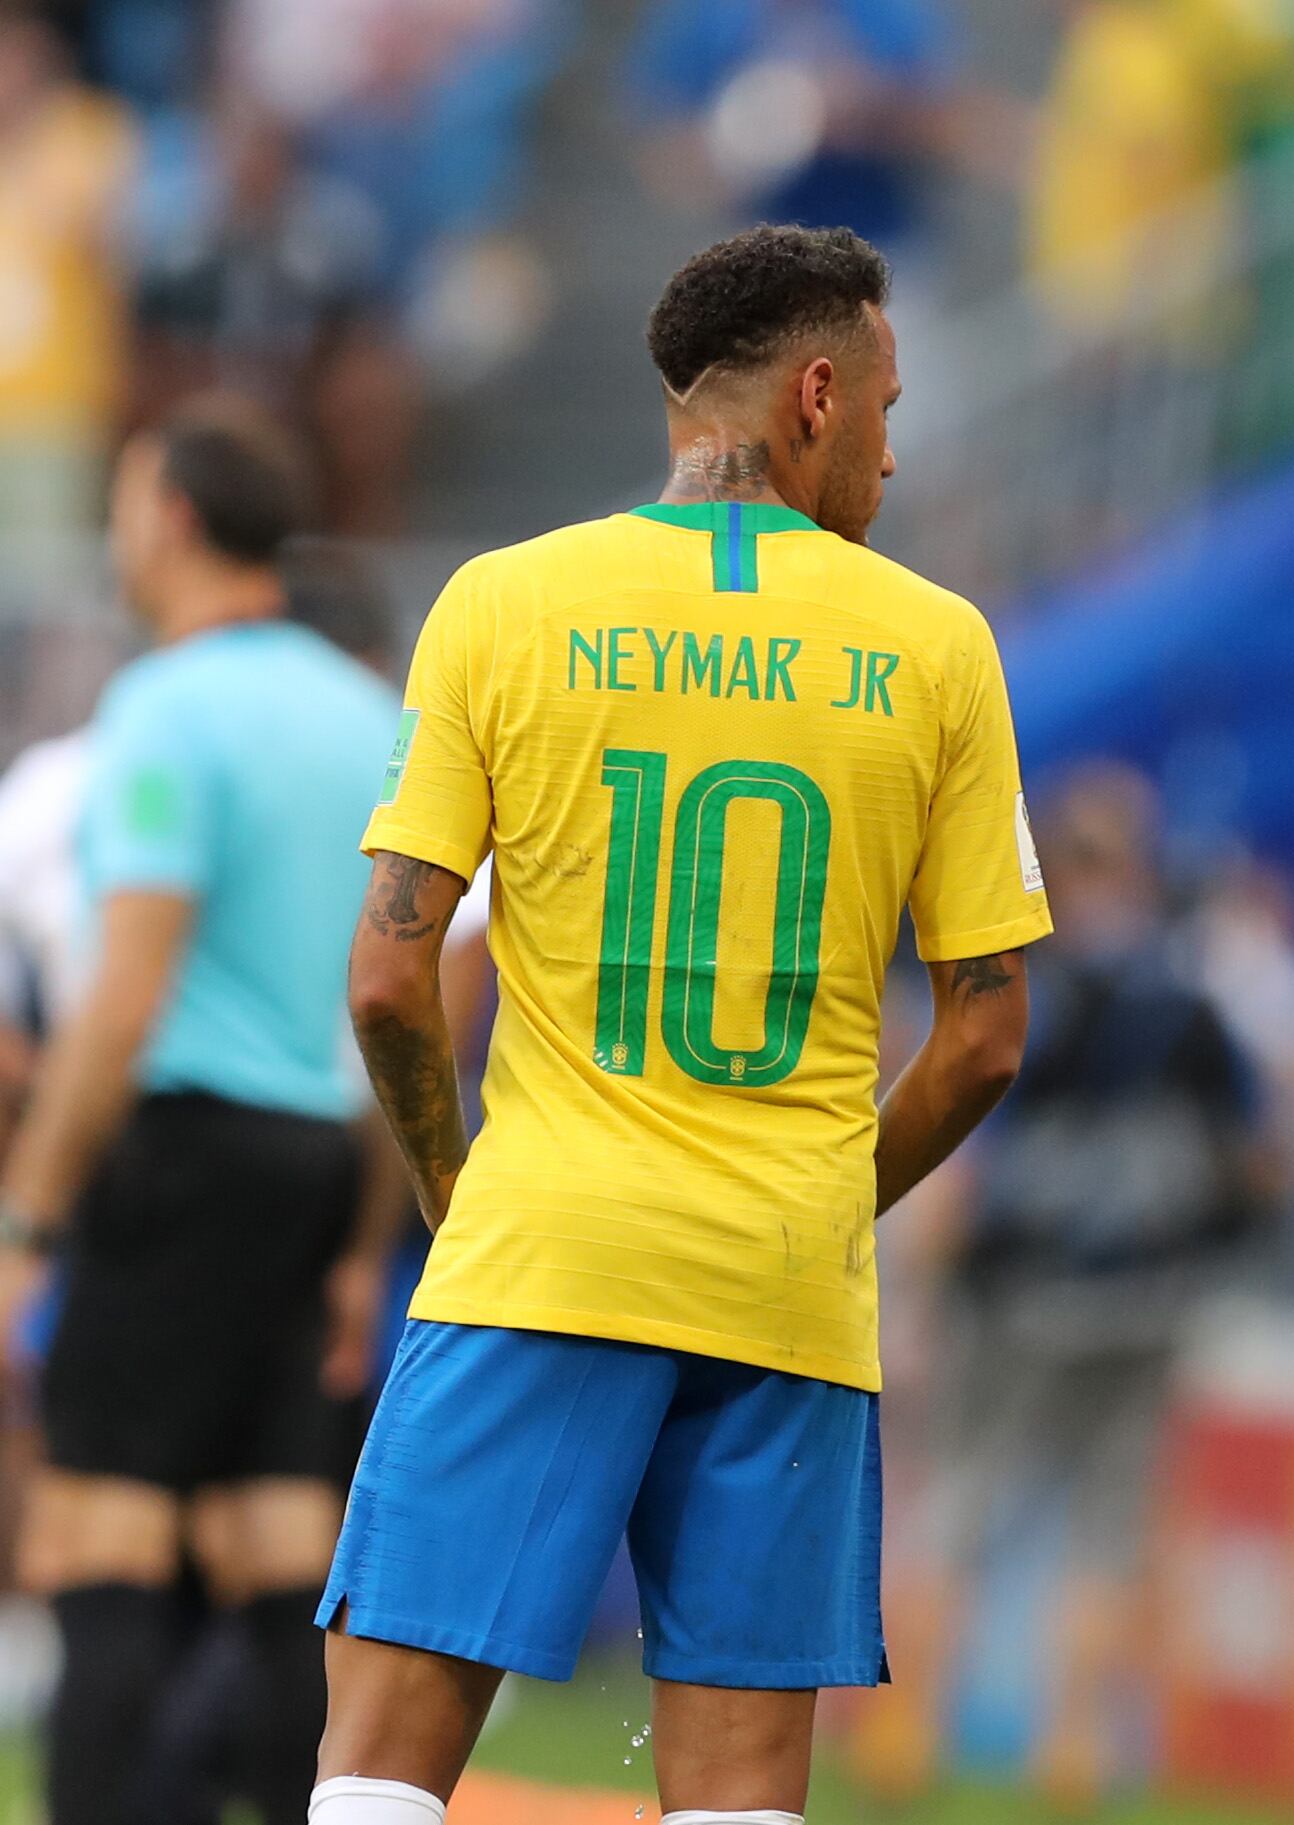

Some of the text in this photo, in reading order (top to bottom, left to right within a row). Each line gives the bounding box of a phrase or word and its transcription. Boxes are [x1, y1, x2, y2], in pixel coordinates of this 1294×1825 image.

[568, 628, 900, 717] NEYMAR JR
[593, 748, 831, 1087] 10
